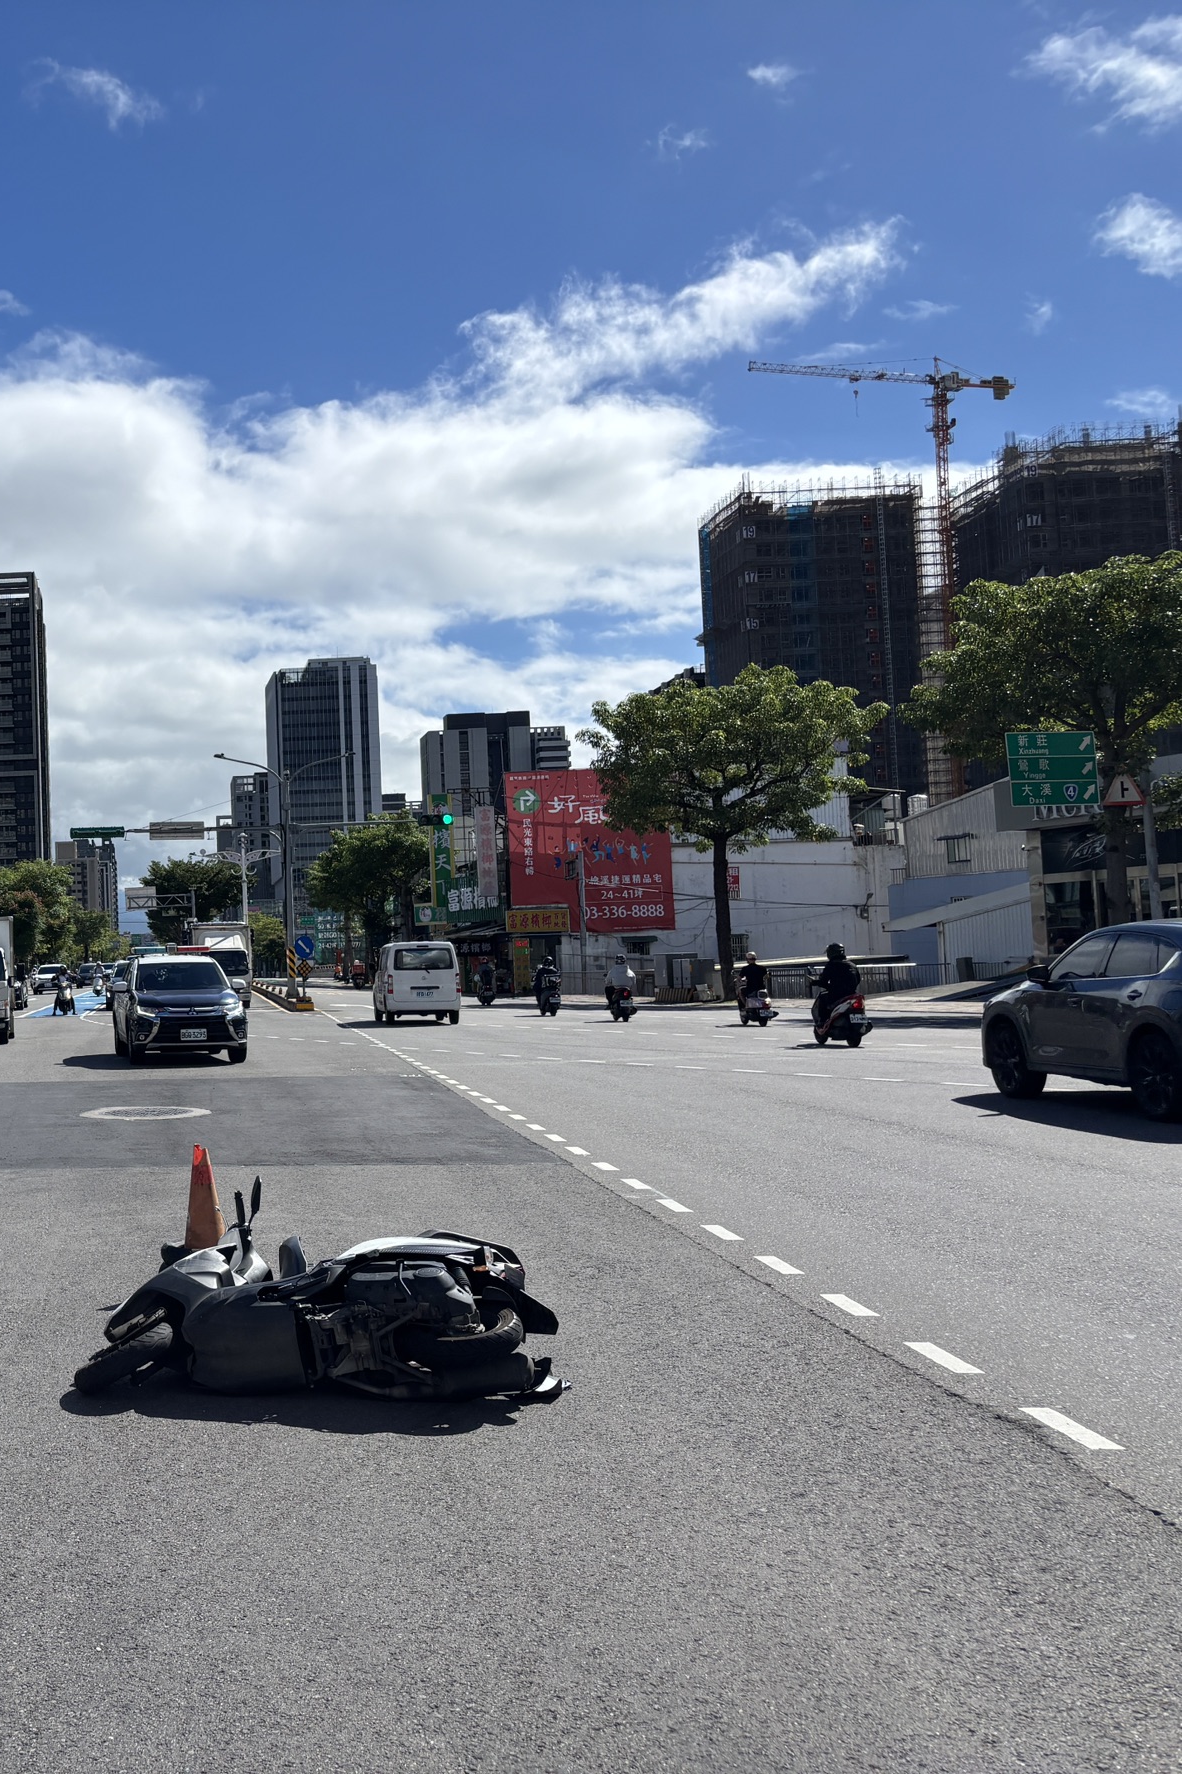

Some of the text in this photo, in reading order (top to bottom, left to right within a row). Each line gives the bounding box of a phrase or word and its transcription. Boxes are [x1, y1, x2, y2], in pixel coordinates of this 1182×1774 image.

[743, 526, 756, 538] 19
[745, 571, 758, 583] 17
[746, 618, 759, 630] 15
[1018, 734, 1048, 747] 新莊
[1018, 747, 1049, 755] Xinzhuang
[1018, 759, 1050, 771] 鶯歌
[1022, 784, 1075, 796] 大溪 4
